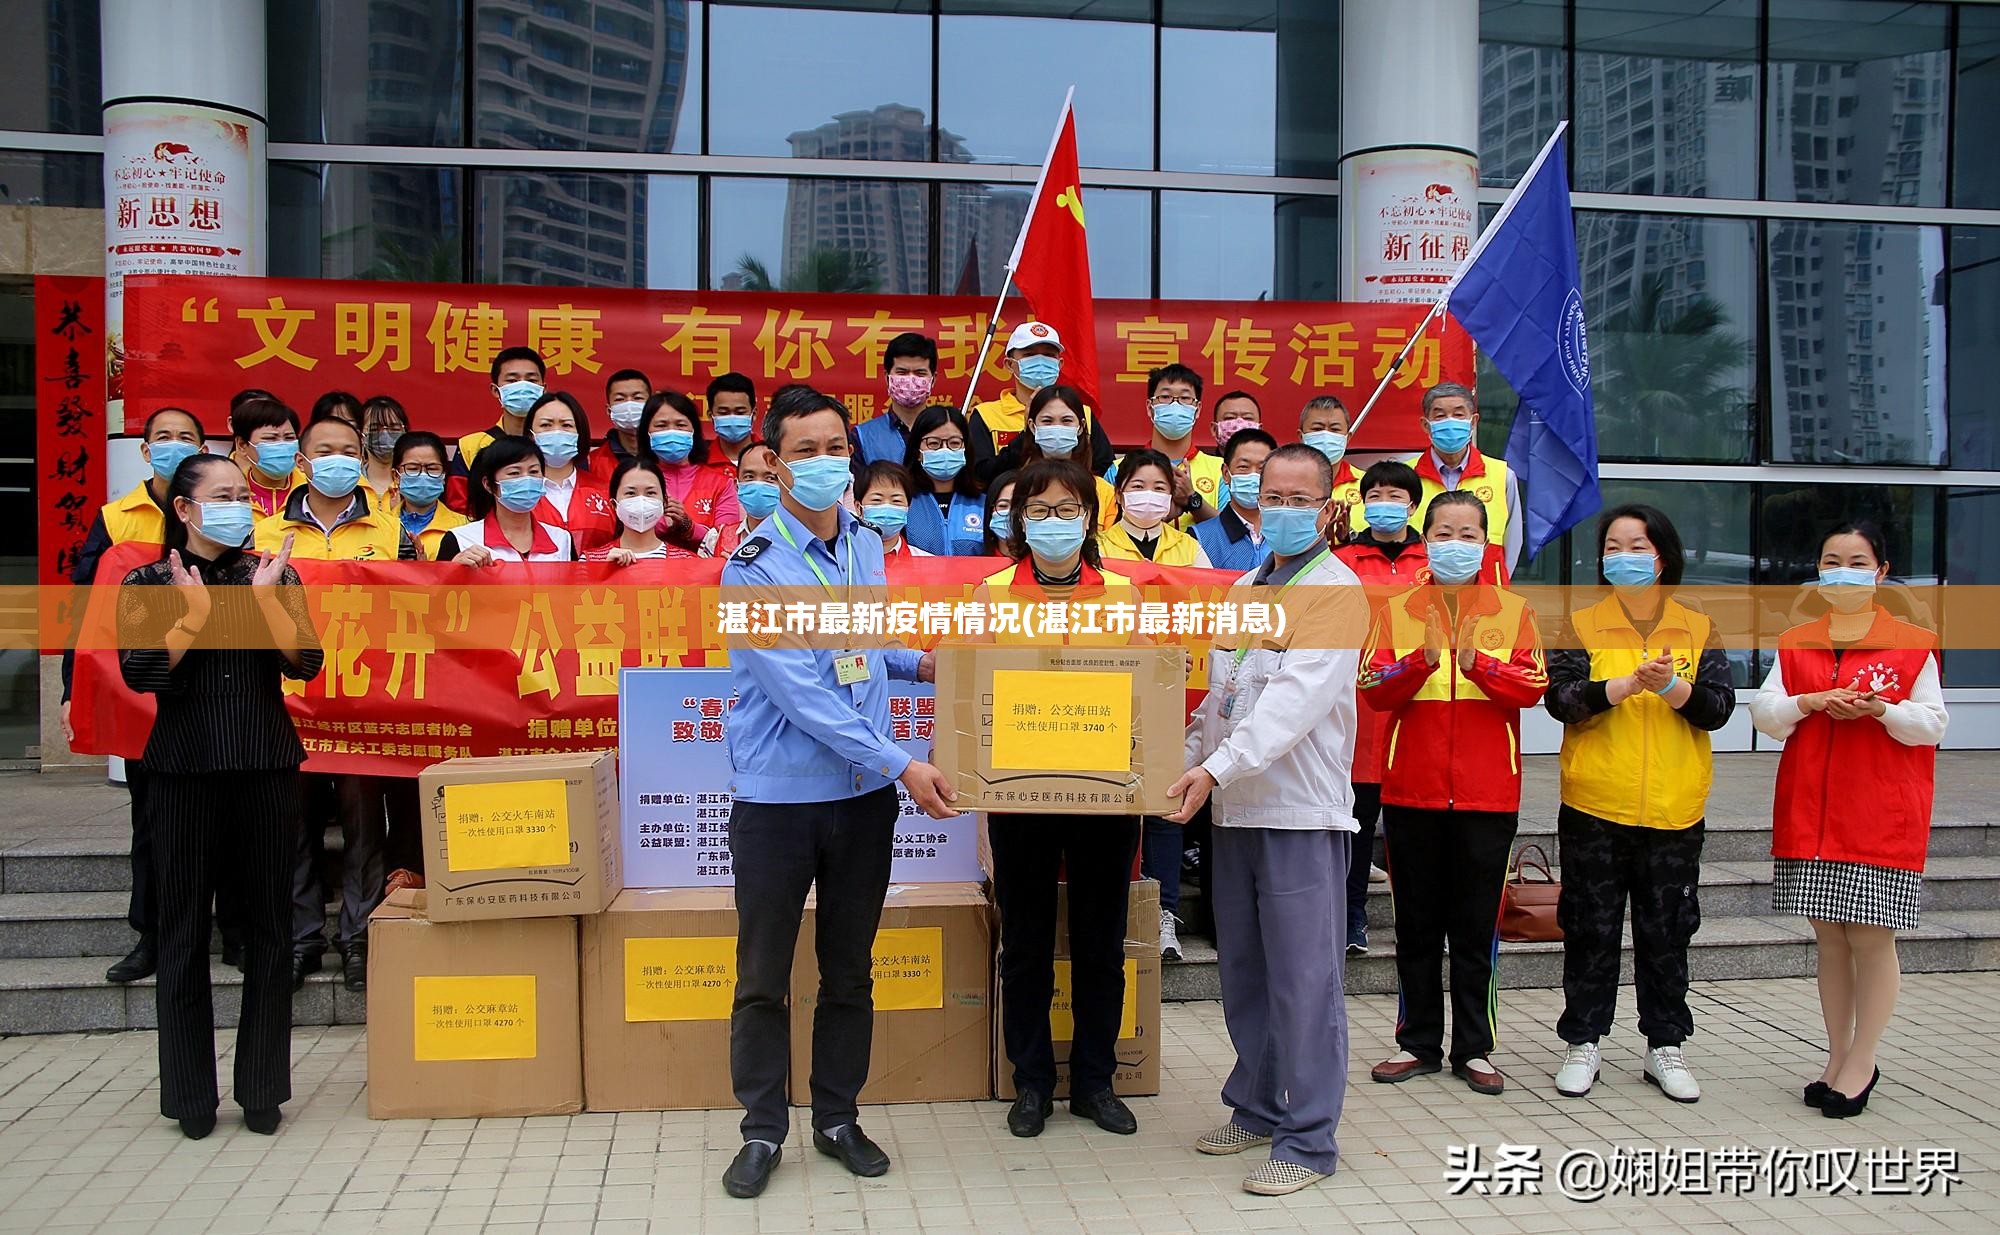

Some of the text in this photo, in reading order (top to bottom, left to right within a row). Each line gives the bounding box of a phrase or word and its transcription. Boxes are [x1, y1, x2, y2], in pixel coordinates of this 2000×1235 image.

[169, 166, 226, 185] 牢记使命
[118, 196, 221, 230] 新思想
[1379, 206, 1427, 219] 不忘初心
[1383, 232, 1470, 262] 新征程
[662, 306, 1036, 379] 有你有我
[1115, 315, 1442, 389] 宣传活动
[281, 584, 472, 700] 花开”
[889, 697, 935, 718] 联盟
[527, 717, 617, 739] 捐赠单位
[672, 721, 725, 743] 致敬
[1083, 723, 1105, 733] 3740
[1108, 722, 1118, 734] 个
[983, 791, 1135, 804] 广东保心安医药科技有限公司
[696, 808, 733, 819] 湛江市
[525, 825, 546, 834] 3330
[548, 822, 558, 833] 个
[445, 890, 581, 906] 广东保心安医药科技有限公司
[902, 969, 921, 979] 3330
[923, 968, 932, 978] 个
[723, 979, 732, 988] 个
[494, 1019, 513, 1027] 4270
[515, 1018, 525, 1027] 个
